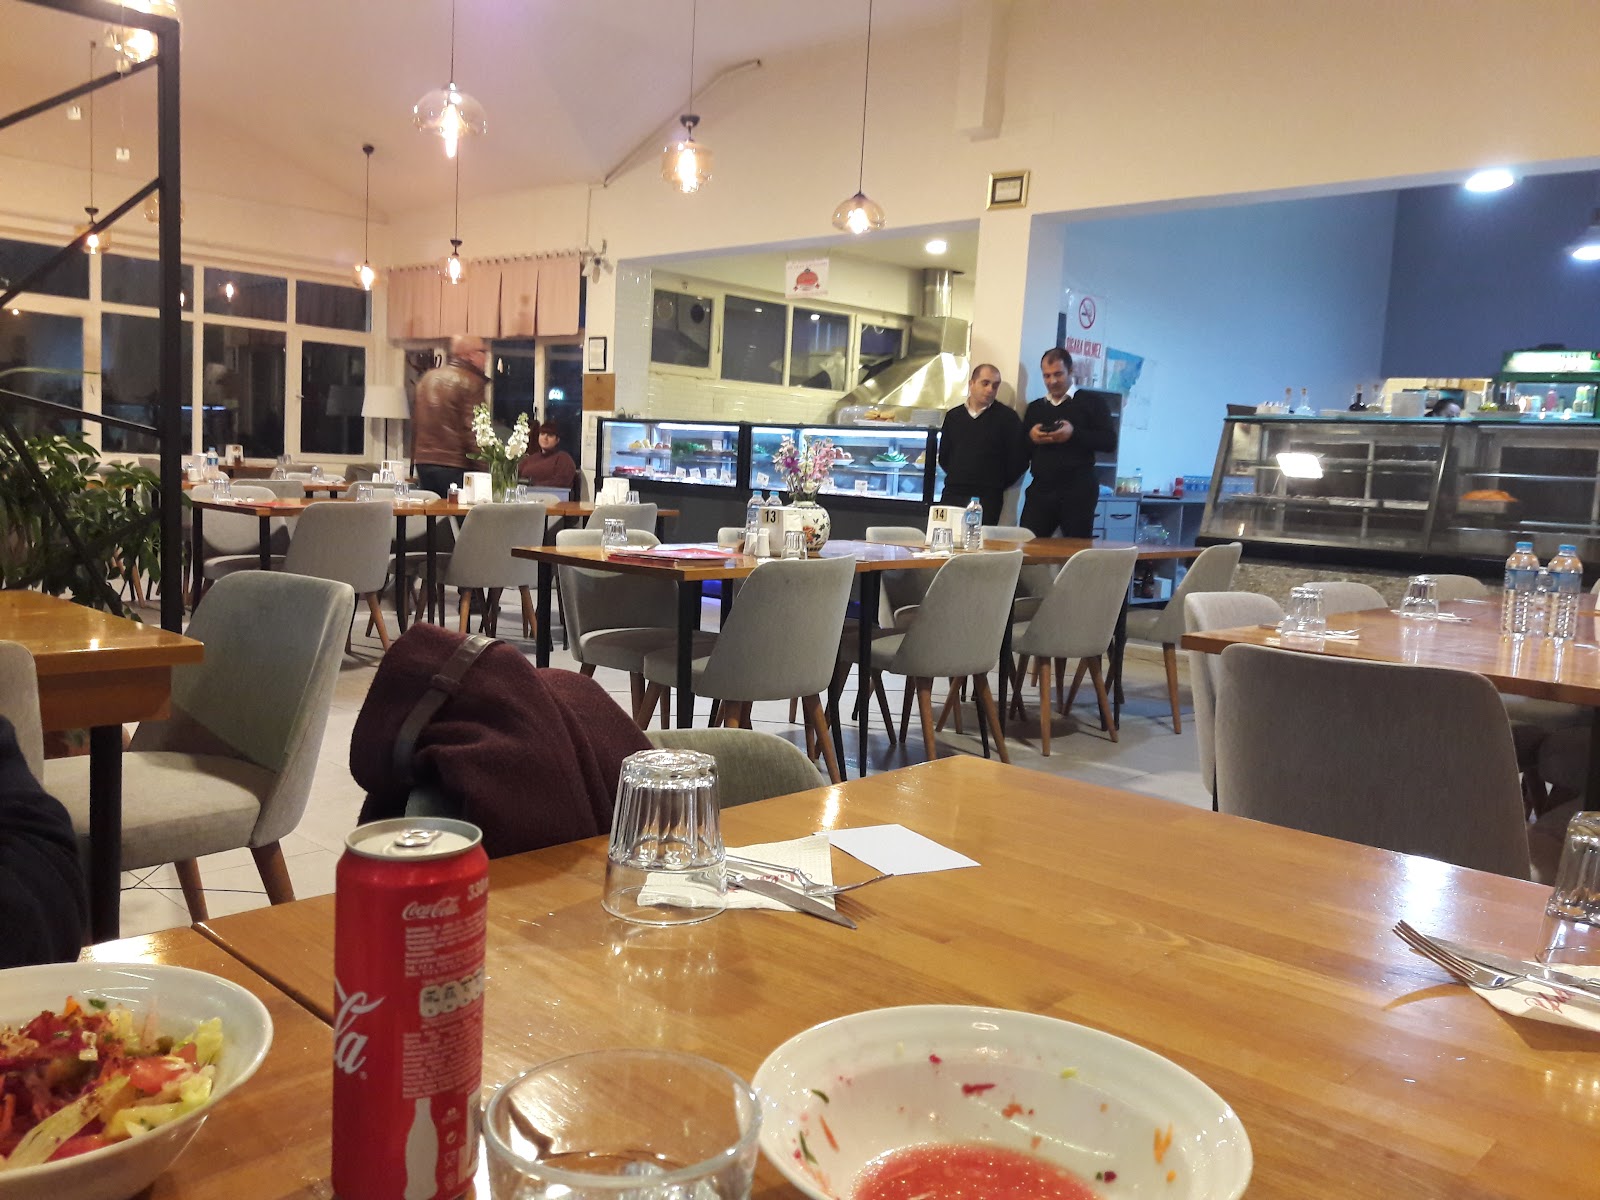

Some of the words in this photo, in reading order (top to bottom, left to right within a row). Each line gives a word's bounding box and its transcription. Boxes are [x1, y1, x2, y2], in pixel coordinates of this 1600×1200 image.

[765, 510, 776, 523] 13
[935, 509, 944, 520] 14
[402, 896, 461, 921] Coca-Cola
